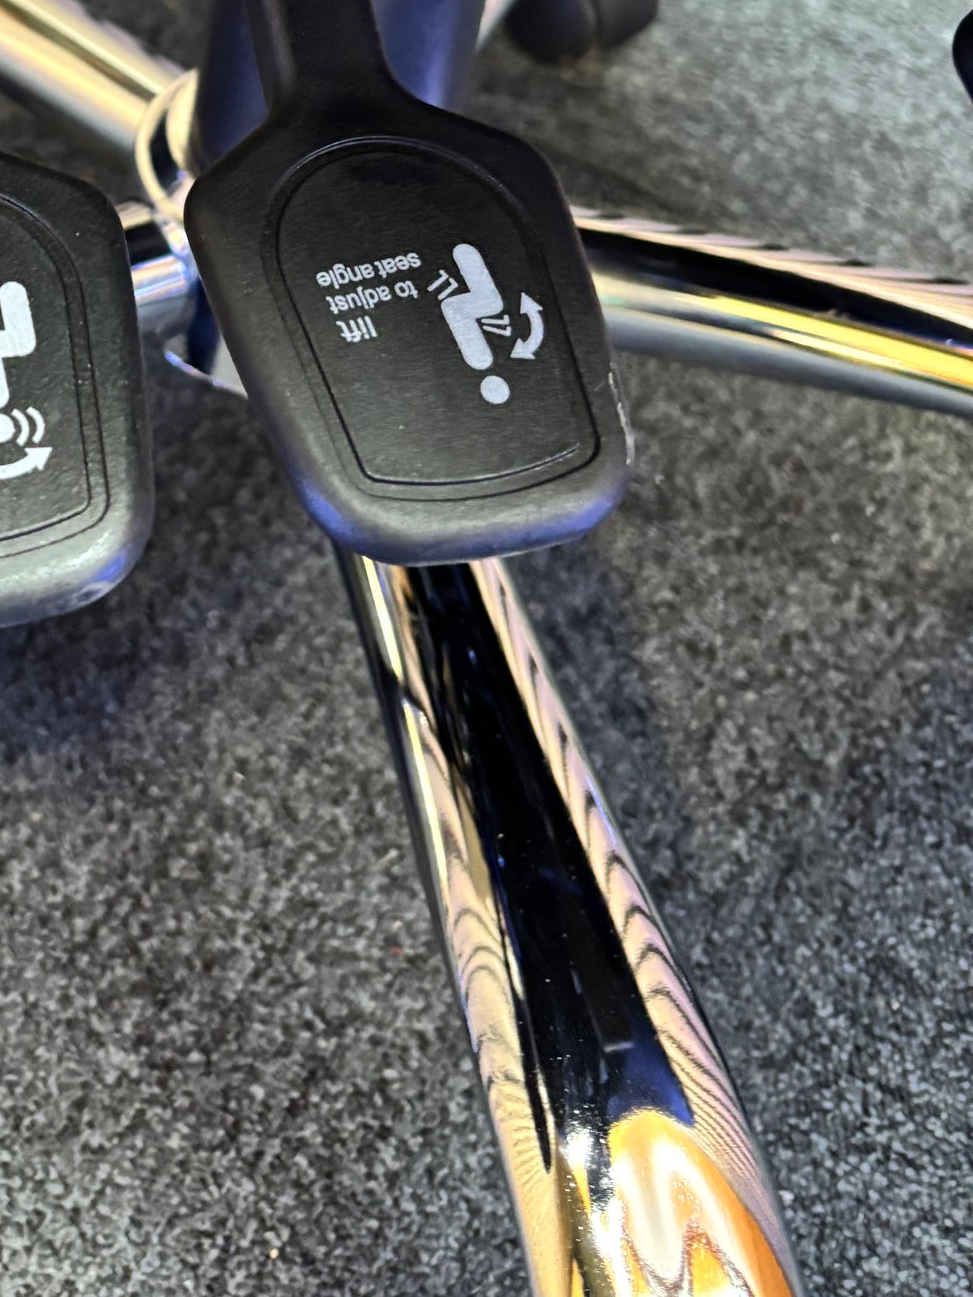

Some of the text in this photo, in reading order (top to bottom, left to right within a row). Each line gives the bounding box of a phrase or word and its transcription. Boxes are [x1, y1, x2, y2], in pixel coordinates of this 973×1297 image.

[315, 252, 422, 290] seat angle
[325, 280, 419, 314] to adjust
[335, 315, 378, 342] lift
